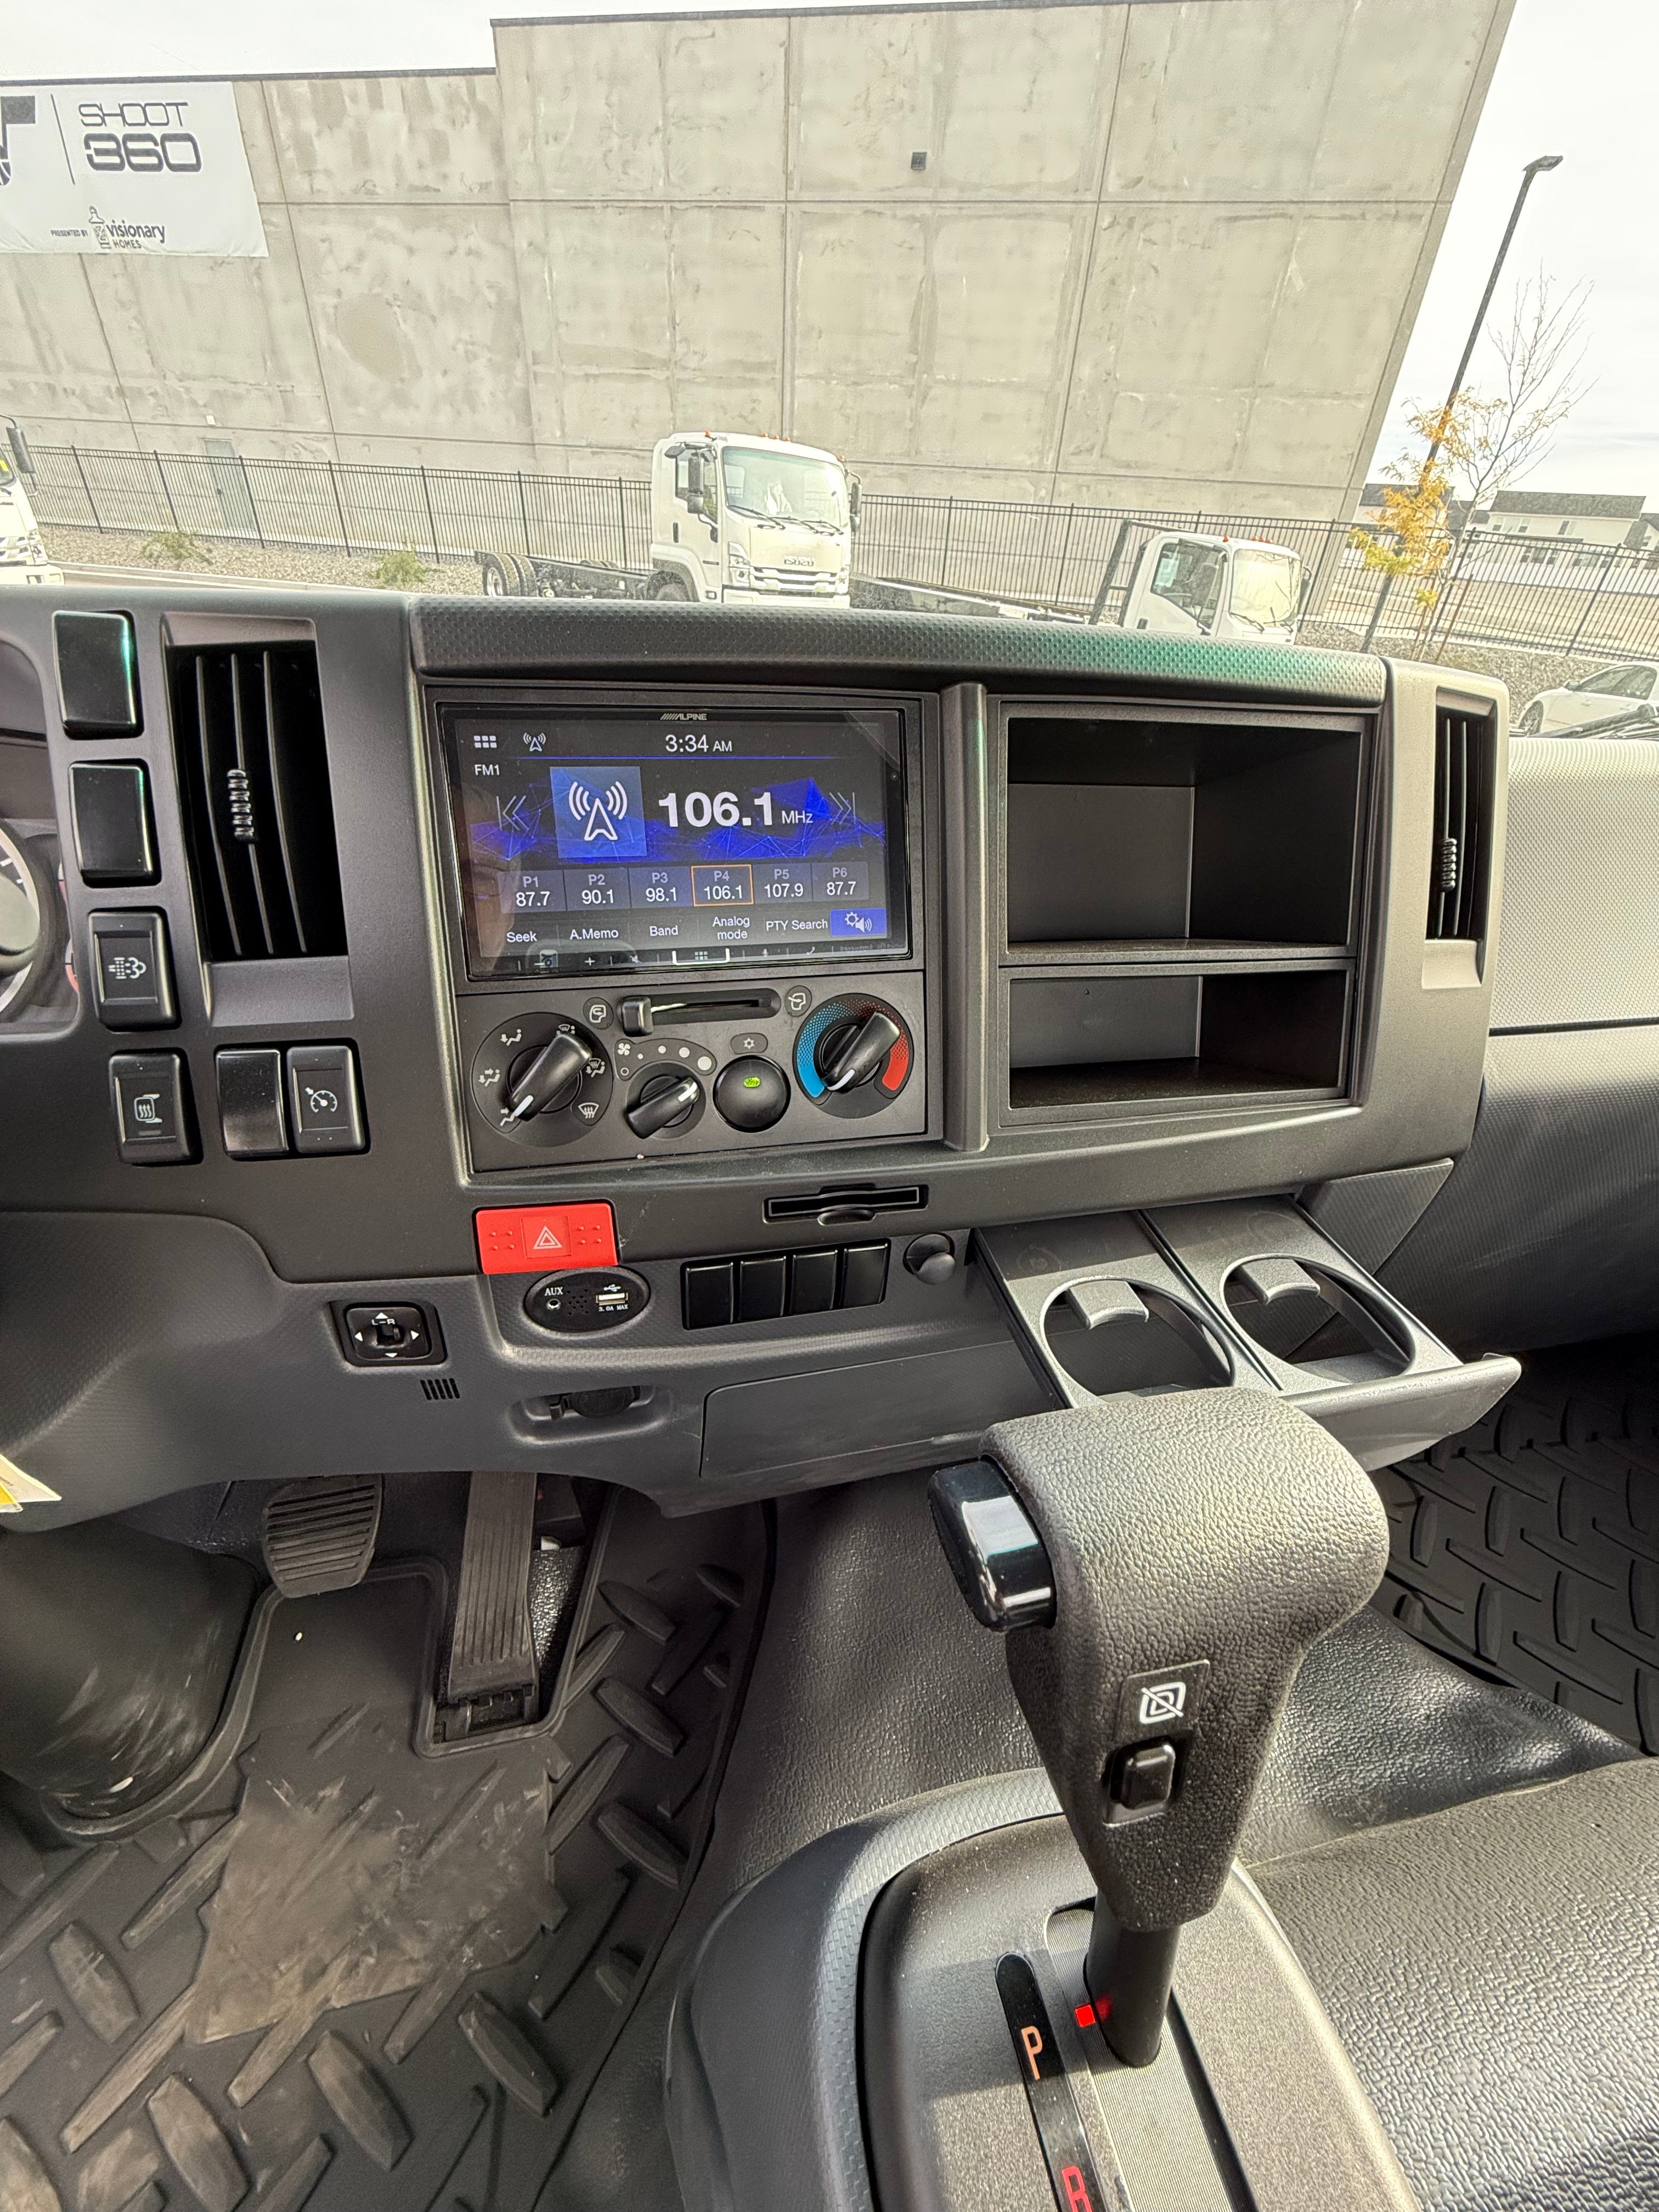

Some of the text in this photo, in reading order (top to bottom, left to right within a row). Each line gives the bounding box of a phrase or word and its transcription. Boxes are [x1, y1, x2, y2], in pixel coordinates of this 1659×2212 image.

[78, 102, 188, 127] SHOOT
[83, 133, 202, 172] 360
[106, 219, 165, 244] visionary
[112, 239, 142, 249] HOMES
[783, 556, 814, 567] ISUZU
[665, 734, 733, 752] 3:34 AM
[474, 764, 500, 776] FM1
[659, 791, 814, 827] 106.1 MHz
[652, 872, 668, 883] P3
[714, 870, 730, 882] P4
[774, 868, 790, 879] P5
[832, 867, 848, 878] P6
[523, 876, 539, 887] P1
[588, 874, 606, 885] P2
[704, 885, 743, 900] 106.1
[764, 883, 804, 898] 107.9
[826, 881, 856, 895] 87.7
[516, 891, 550, 906] 87.7
[582, 889, 614, 904] 90.1
[646, 887, 677, 902] 98.1
[712, 916, 750, 928] Analog
[766, 919, 828, 932] PTY Search
[570, 928, 619, 940] A.Memo
[650, 925, 679, 936] Band
[718, 929, 748, 940] mode
[506, 931, 538, 943] Seek
[544, 1286, 564, 1296] AUX
[1022, 2025, 1042, 2080] P
[1062, 2165, 1093, 2212] R
